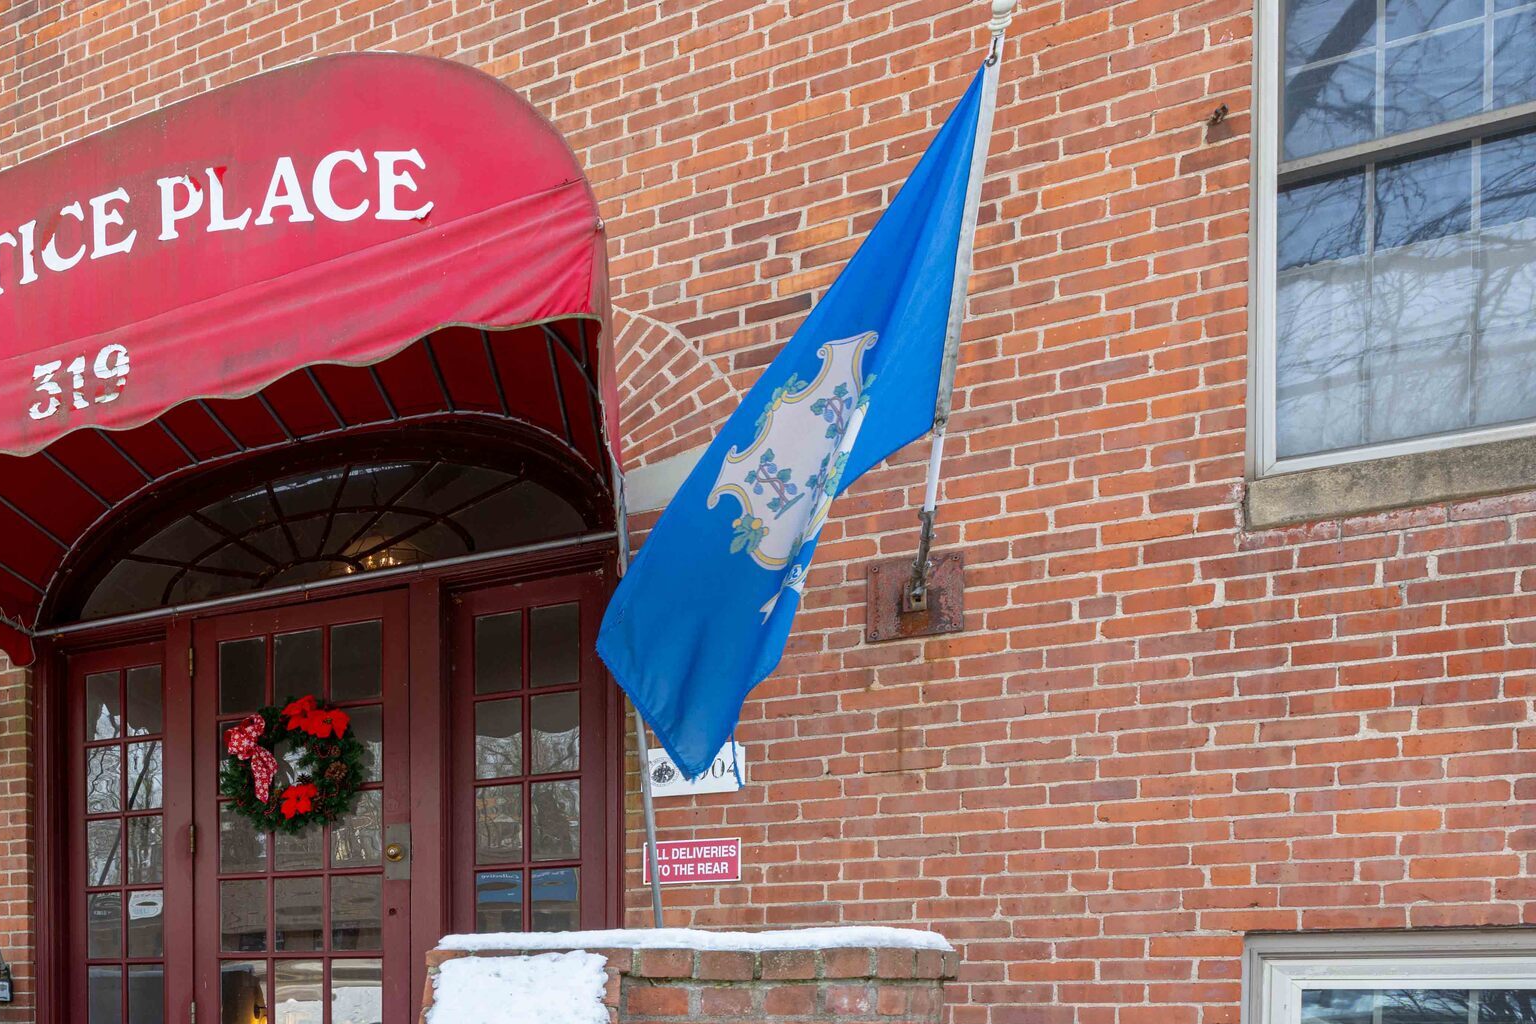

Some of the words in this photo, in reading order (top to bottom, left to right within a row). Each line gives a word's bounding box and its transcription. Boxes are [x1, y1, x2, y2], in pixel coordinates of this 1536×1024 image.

[157, 148, 434, 243] PLACE
[29, 344, 130, 419] 319
[671, 845, 736, 860] DELIVERIES
[673, 863, 695, 876] THE
[697, 862, 729, 875] REAR
